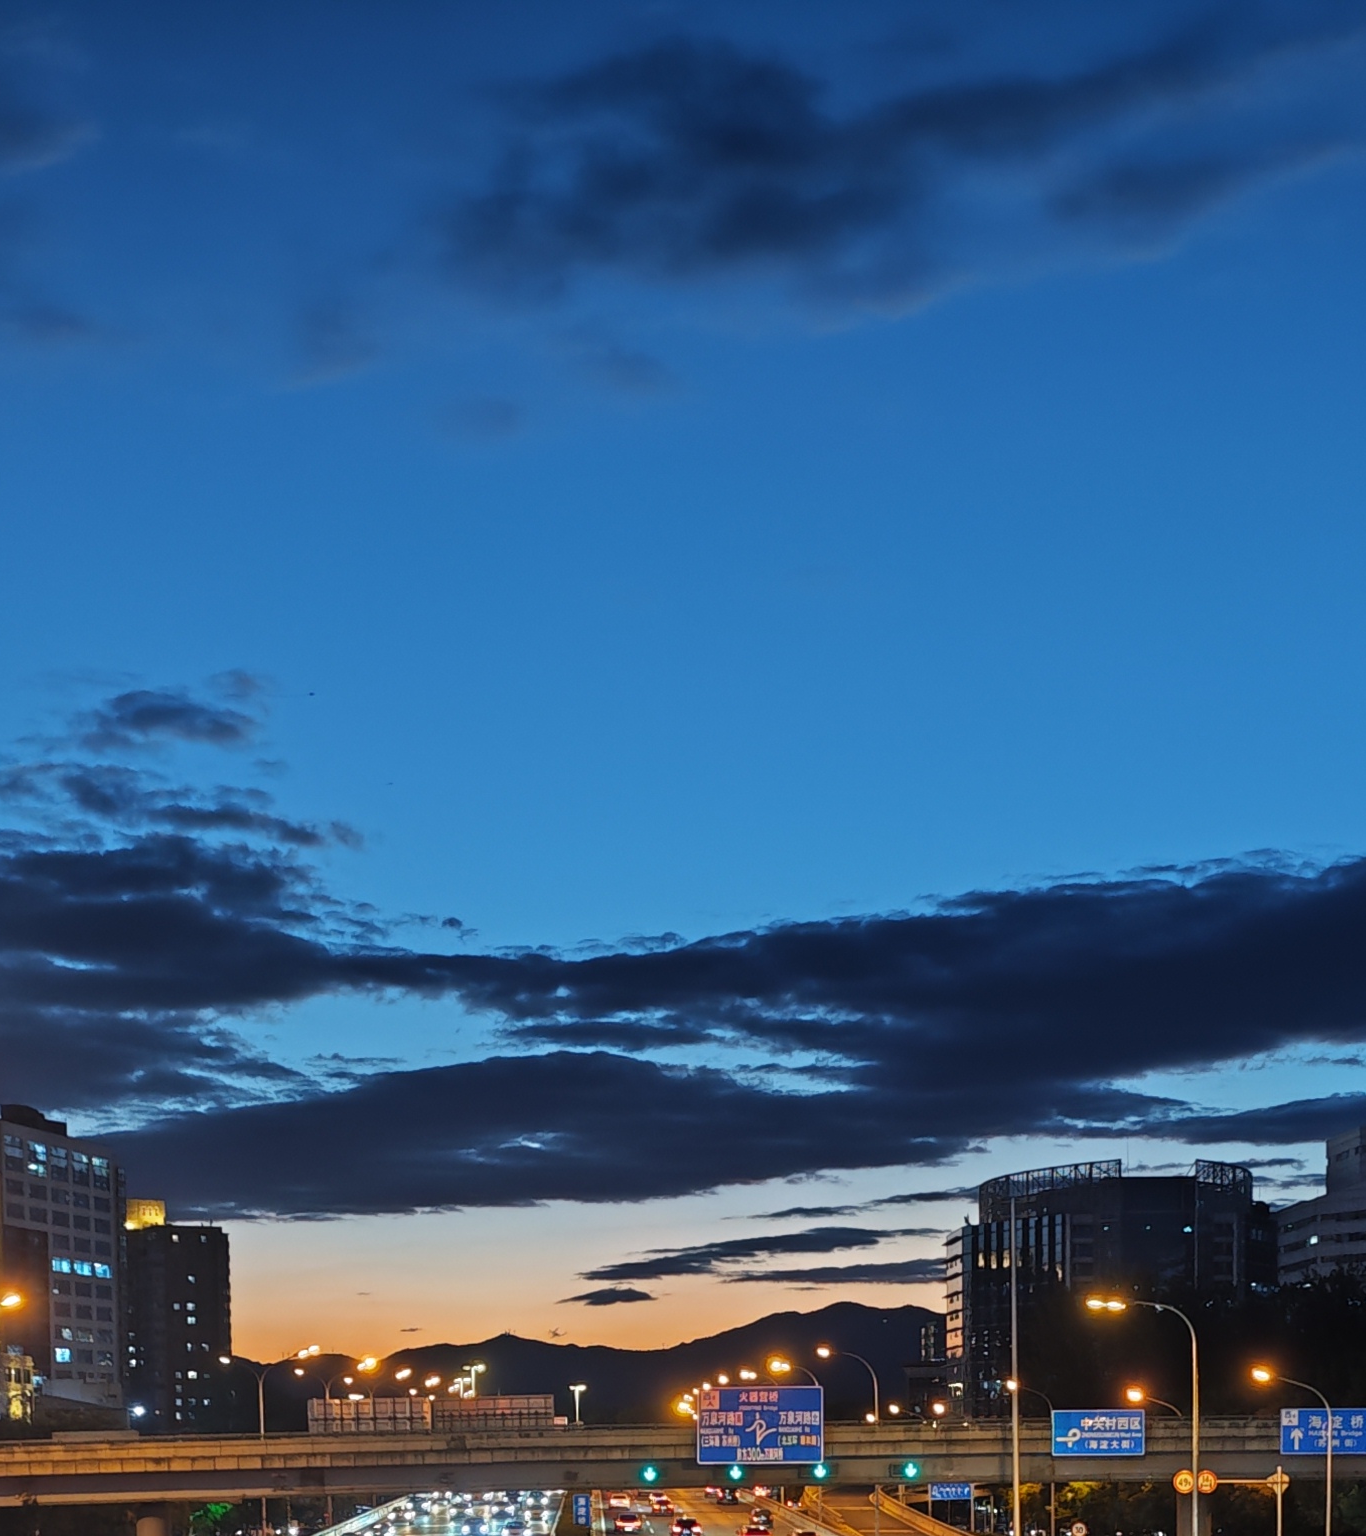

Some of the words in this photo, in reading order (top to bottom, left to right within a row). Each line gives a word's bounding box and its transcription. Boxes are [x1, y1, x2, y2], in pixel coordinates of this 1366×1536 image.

[1080, 1416, 1142, 1431] 中关村西区
